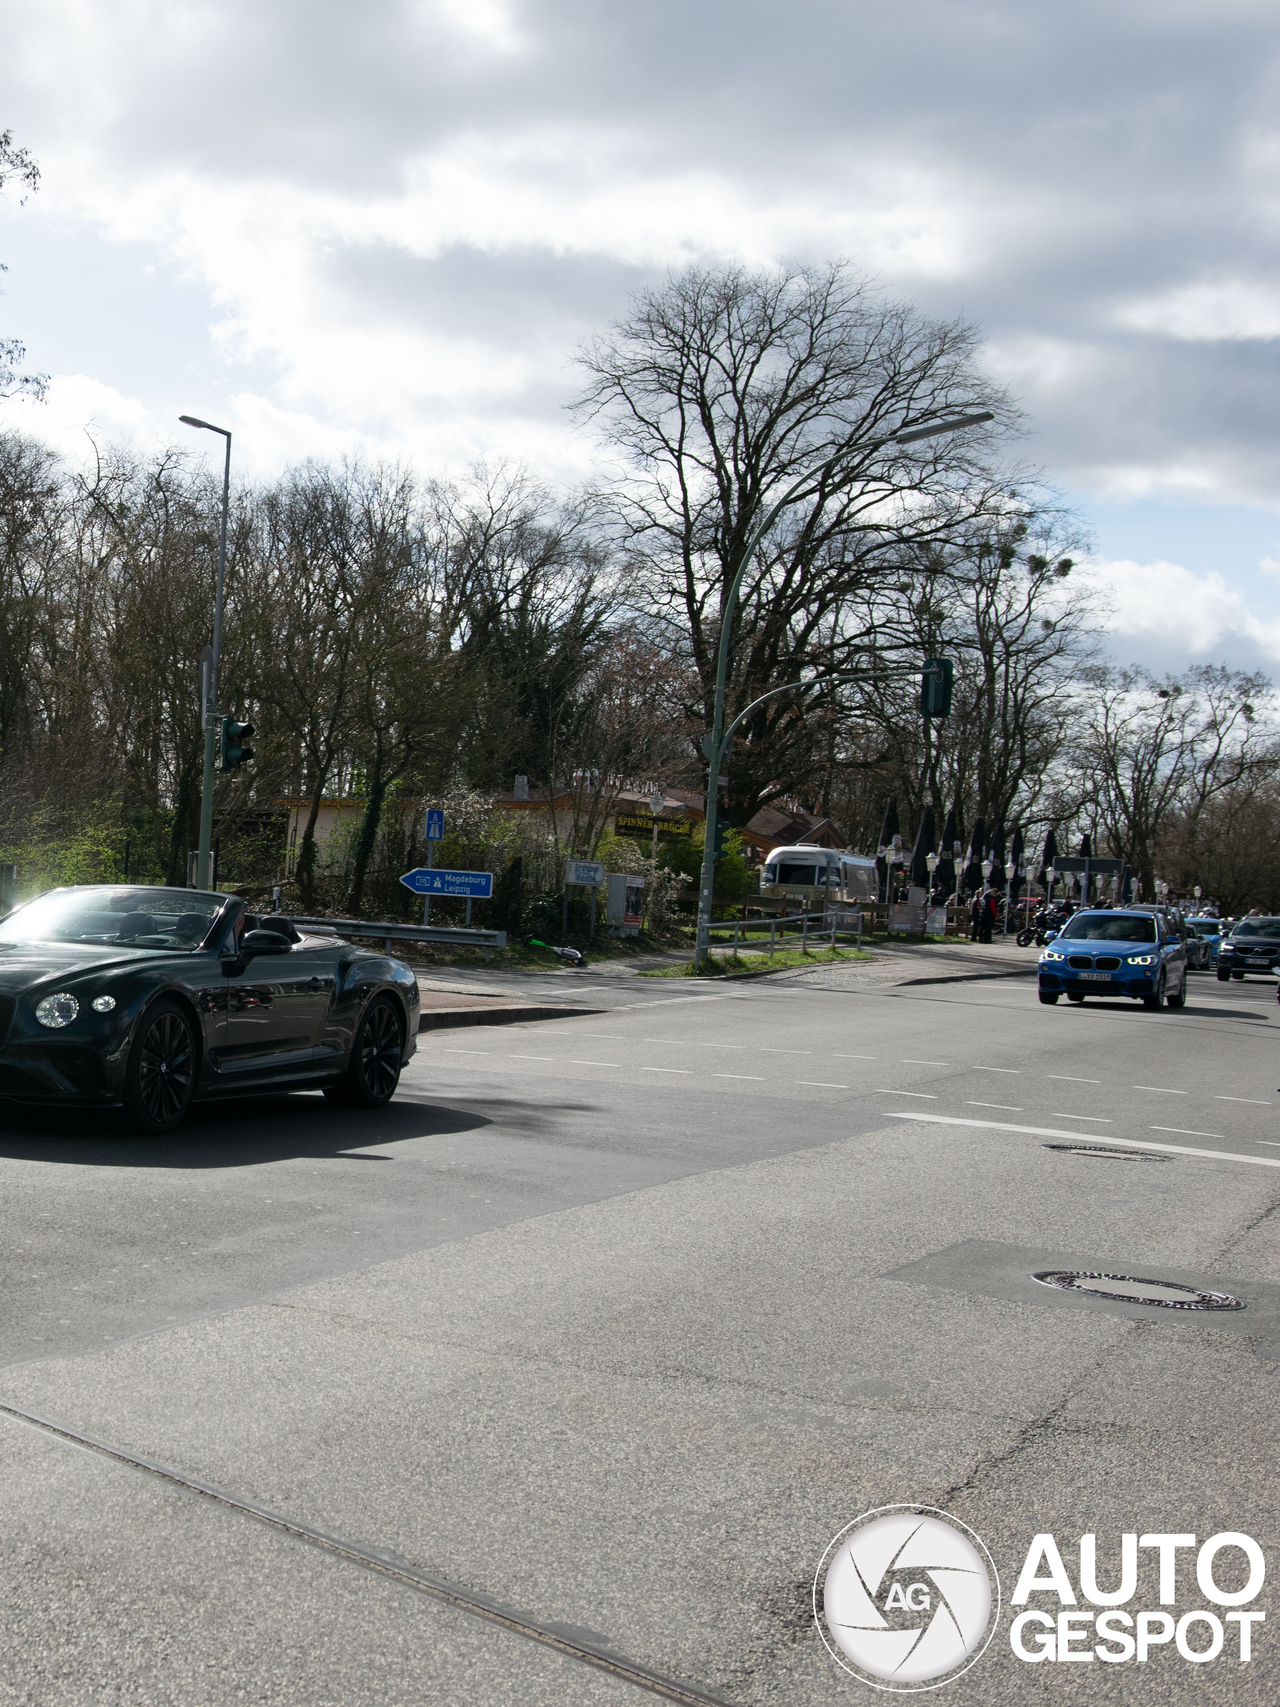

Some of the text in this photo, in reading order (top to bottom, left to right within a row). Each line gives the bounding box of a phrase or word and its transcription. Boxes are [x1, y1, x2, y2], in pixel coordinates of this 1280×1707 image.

[618, 816, 653, 829] SPINNER
[445, 874, 486, 886] Magdeburg
[445, 884, 470, 894] Leipzig
